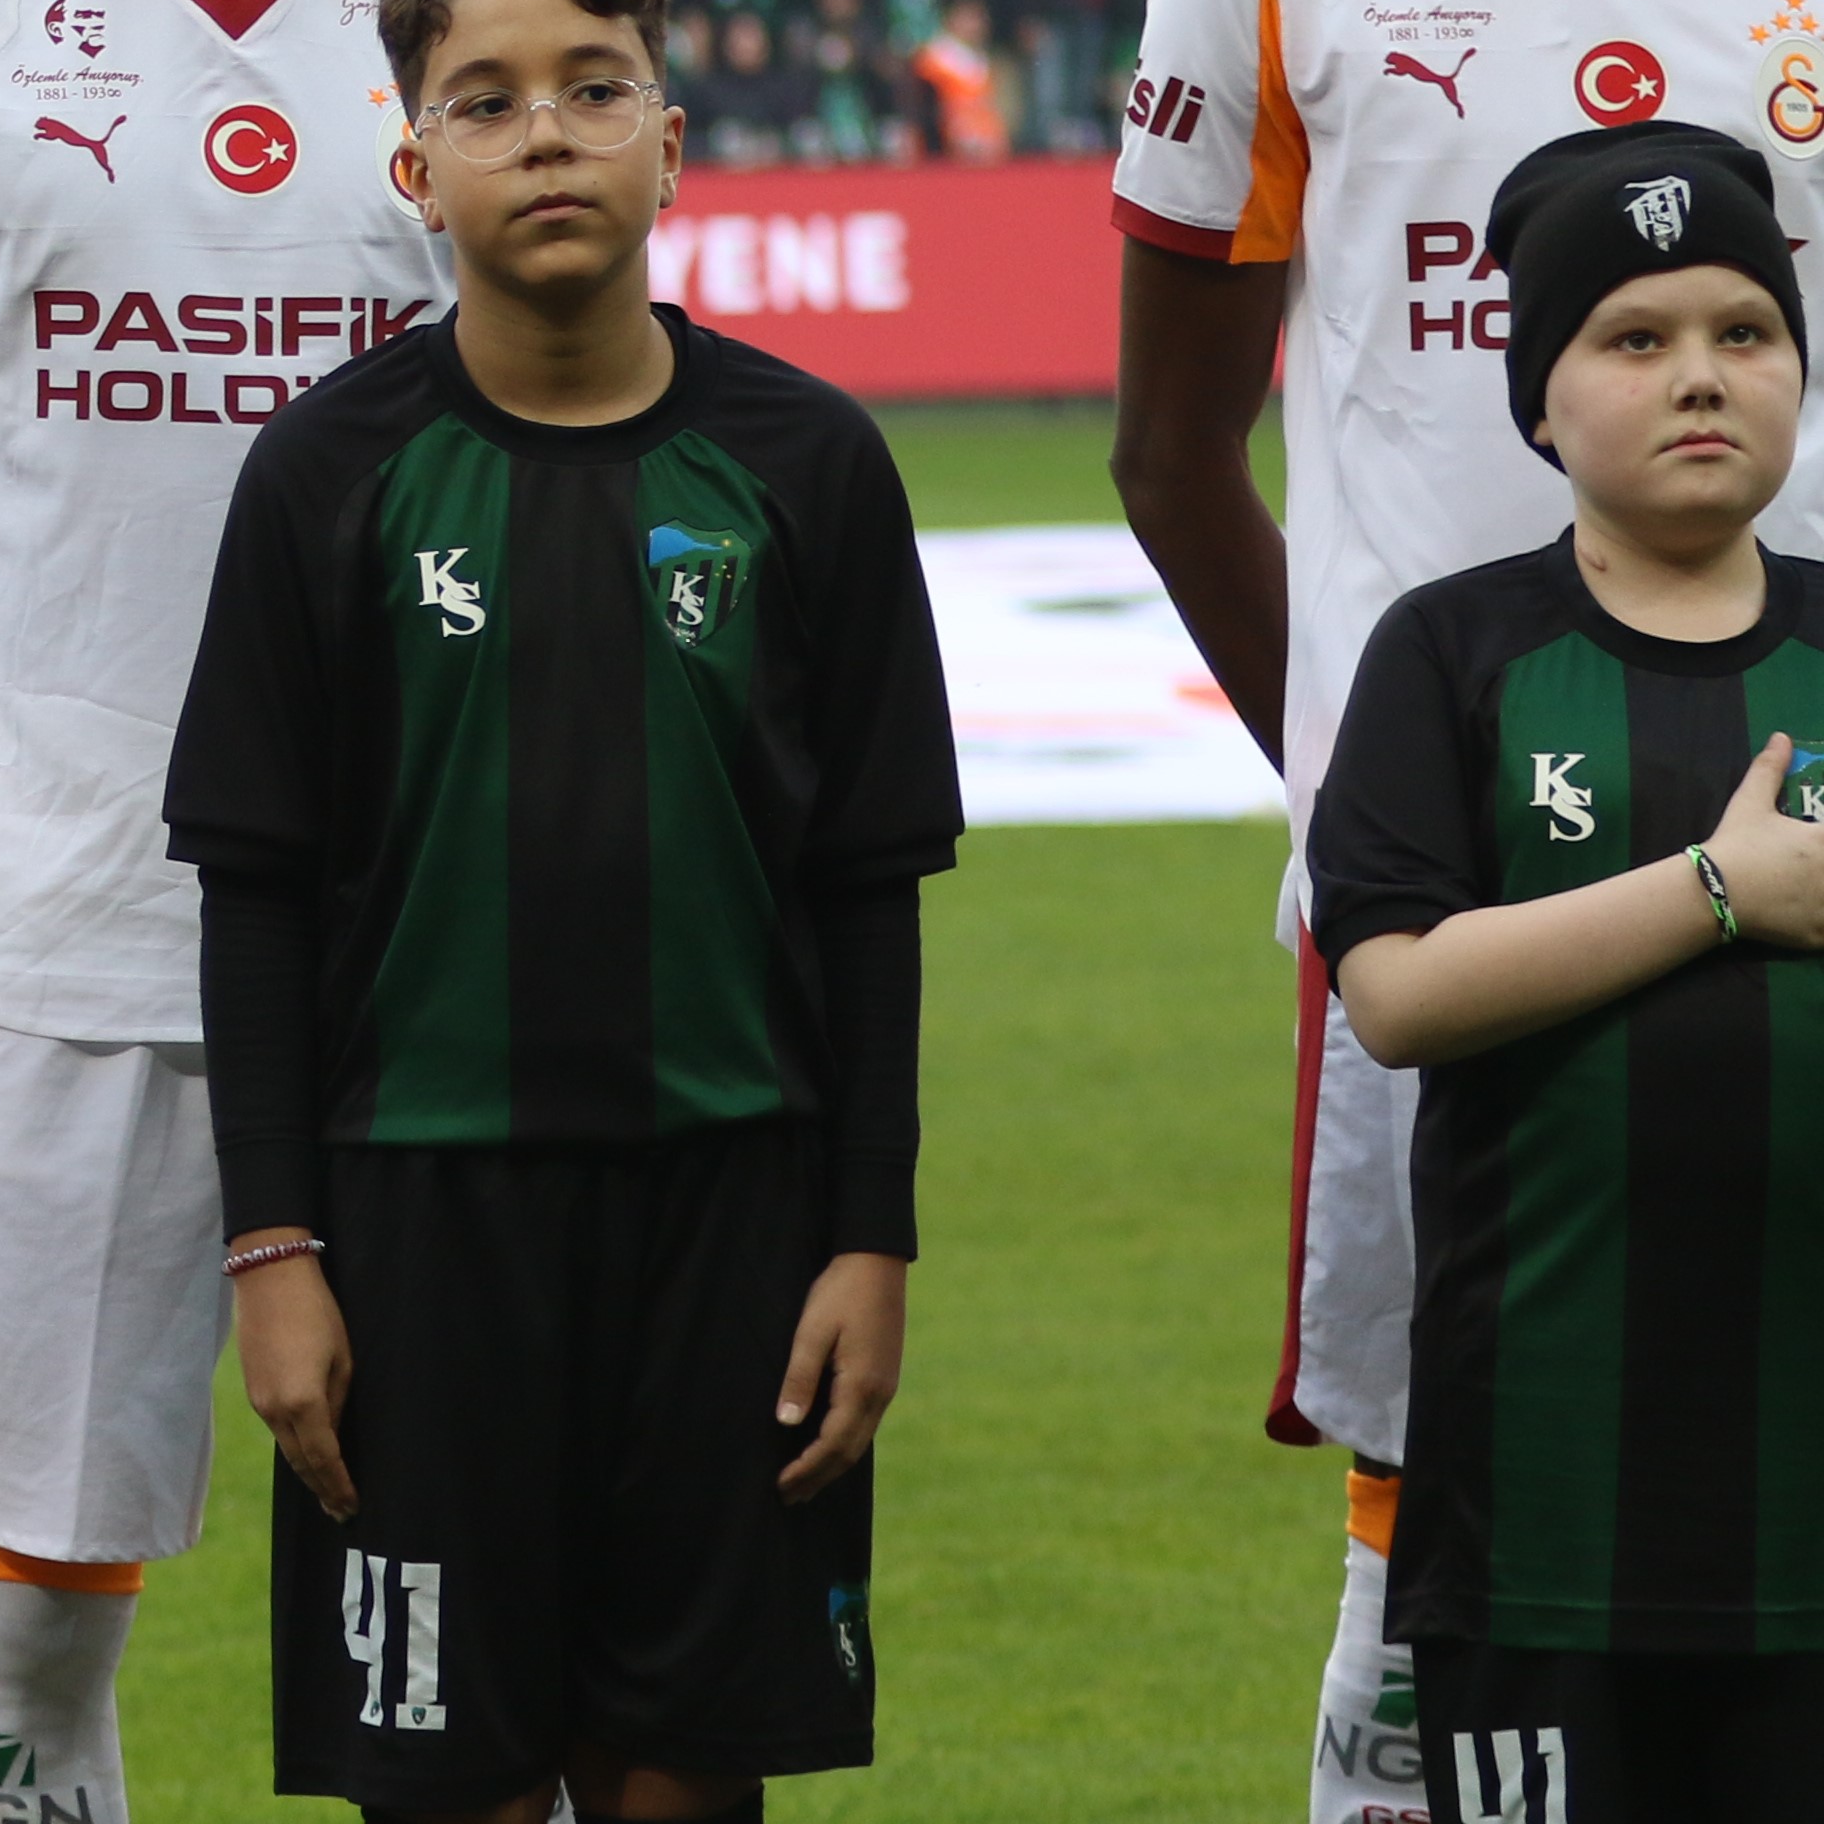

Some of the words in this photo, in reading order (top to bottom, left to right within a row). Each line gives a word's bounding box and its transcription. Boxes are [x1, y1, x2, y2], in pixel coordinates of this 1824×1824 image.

[1388, 27, 1420, 41] 1881
[11, 64, 69, 88] Özlemle
[36, 88, 68, 100] 1881
[1126, 58, 1206, 144] sli
[341, 1547, 446, 1731] 41
